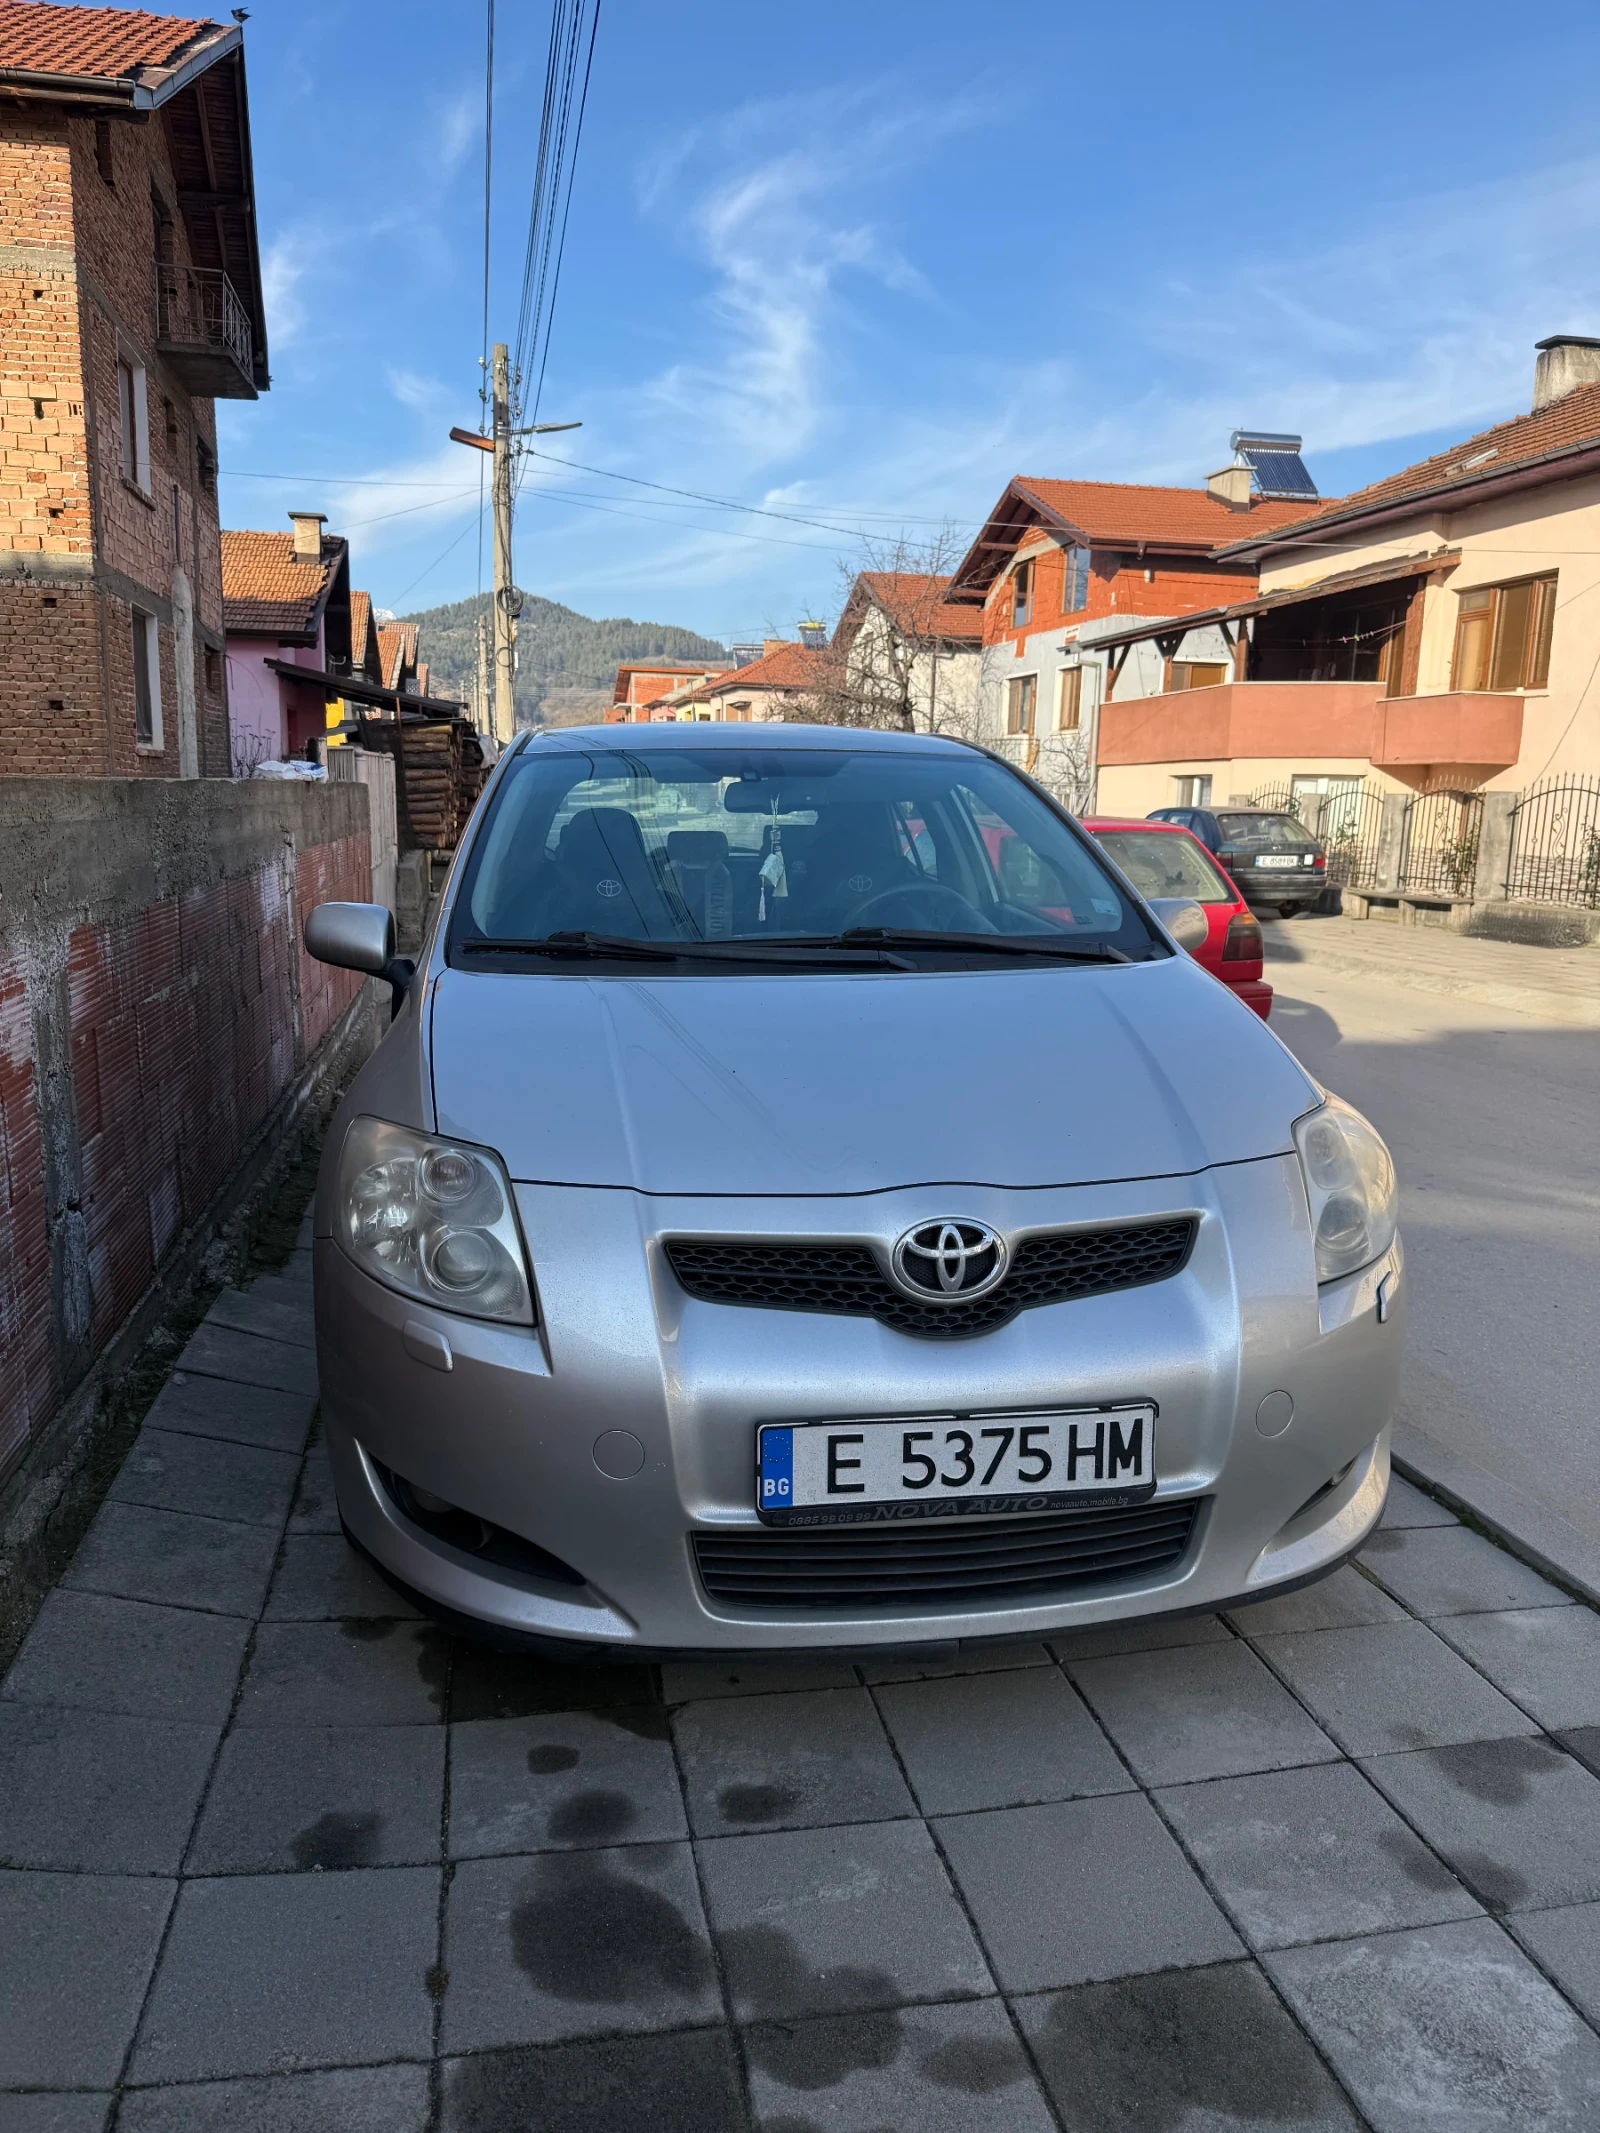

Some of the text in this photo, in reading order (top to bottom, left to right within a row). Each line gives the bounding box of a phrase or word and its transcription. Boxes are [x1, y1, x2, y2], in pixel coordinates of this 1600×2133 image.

[827, 1417, 1144, 1493] E 5375 HM
[763, 1477, 790, 1497] BG
[788, 1515, 819, 1526] 0885
[873, 1501, 960, 1519] NOVA
[965, 1496, 1048, 1513] AUTO
[1050, 1495, 1129, 1509] novaauto.mobile.bg
